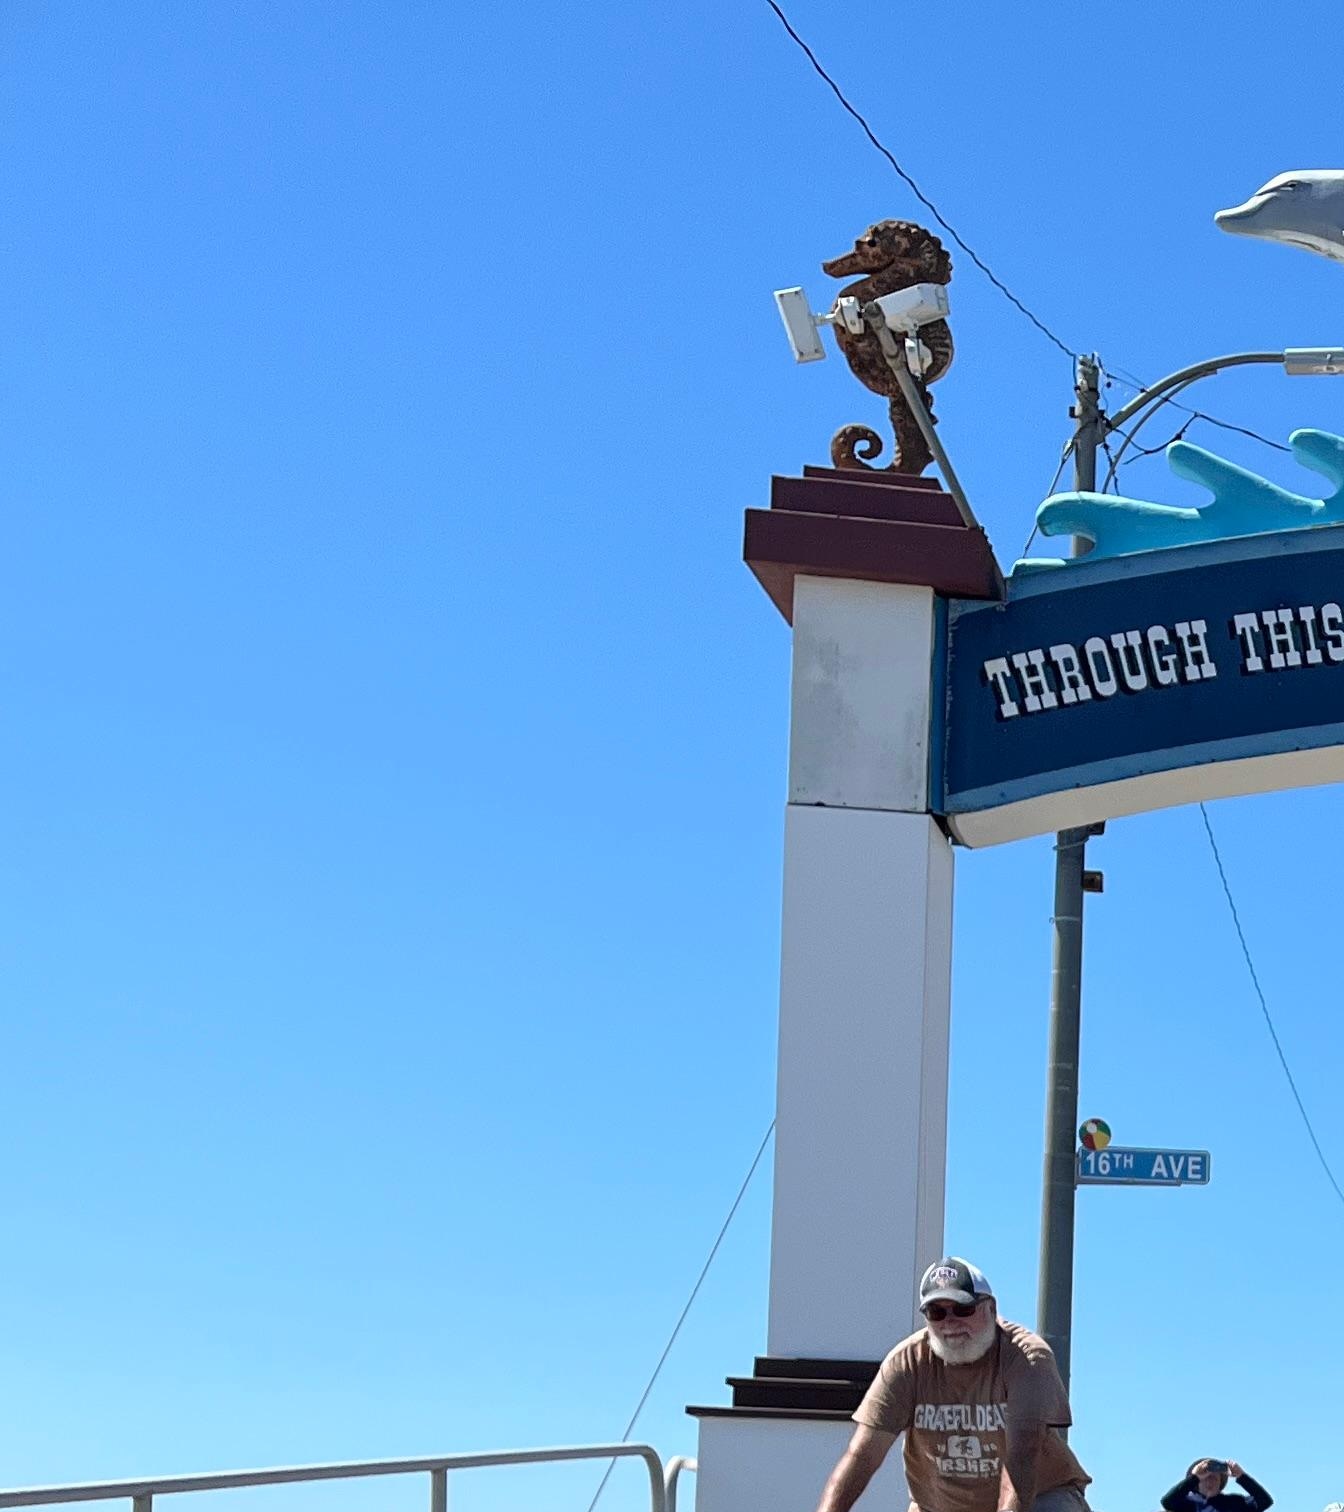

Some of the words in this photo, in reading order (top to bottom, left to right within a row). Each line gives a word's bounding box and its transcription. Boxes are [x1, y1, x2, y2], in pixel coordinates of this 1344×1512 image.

[984, 619, 1217, 717] THROUGH
[1086, 1152, 1134, 1175] 16TH
[1151, 1155, 1202, 1179] AVE
